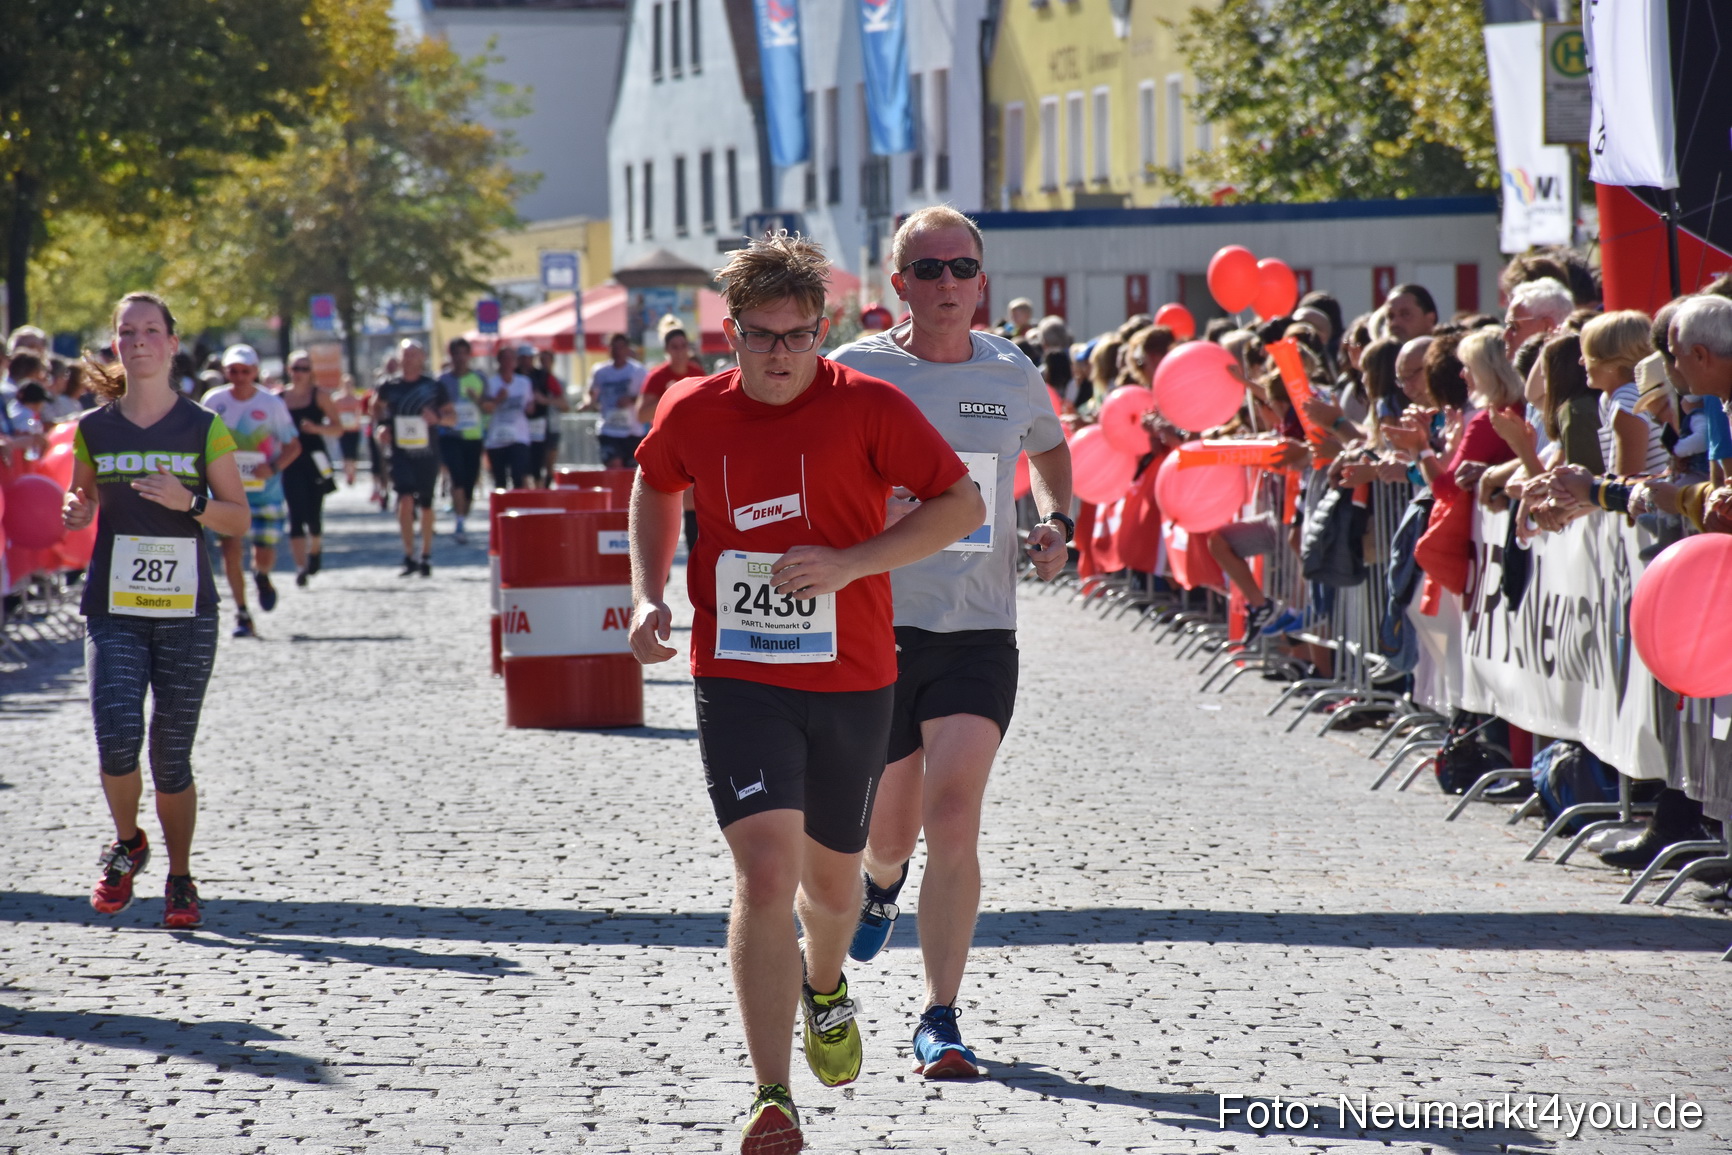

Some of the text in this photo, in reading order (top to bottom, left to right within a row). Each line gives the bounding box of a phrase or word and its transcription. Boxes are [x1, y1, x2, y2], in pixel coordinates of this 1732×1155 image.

[1564, 41, 1586, 66] H
[959, 402, 1007, 416] BOCK
[94, 452, 199, 477] BOCK
[752, 504, 783, 521] DEHN
[138, 543, 175, 553] BOCK
[132, 558, 178, 583] 287
[747, 562, 773, 574] BO
[136, 595, 172, 607] Sandra
[733, 582, 817, 617] 2430
[602, 607, 634, 631] AV
[741, 619, 763, 629] PARTL
[750, 635, 800, 650] Manuel
